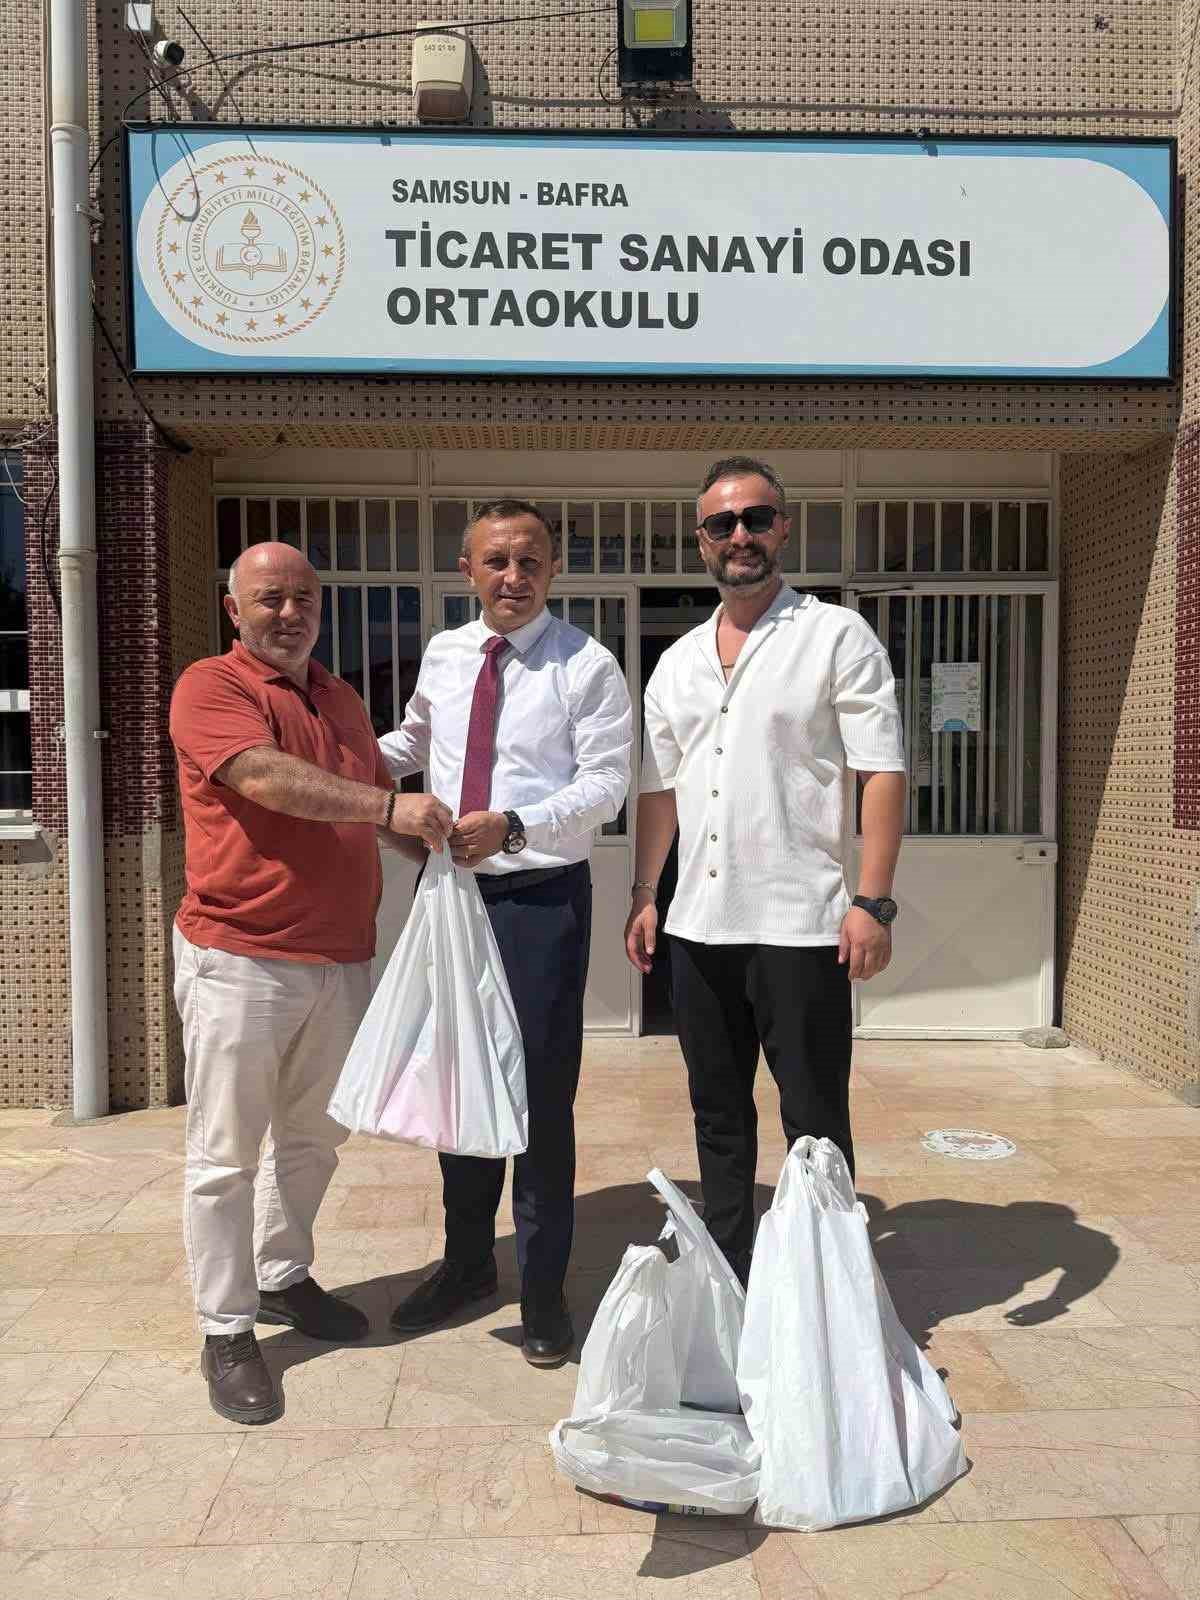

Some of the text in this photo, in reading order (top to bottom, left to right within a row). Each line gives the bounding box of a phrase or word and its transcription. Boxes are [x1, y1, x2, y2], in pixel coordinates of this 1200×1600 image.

[391, 178, 510, 205] SAMSUN
[537, 181, 629, 207] BAFRA
[384, 220, 971, 277] TİCARET SANAYİ ODASI
[386, 286, 699, 330] ORTAOKULU
